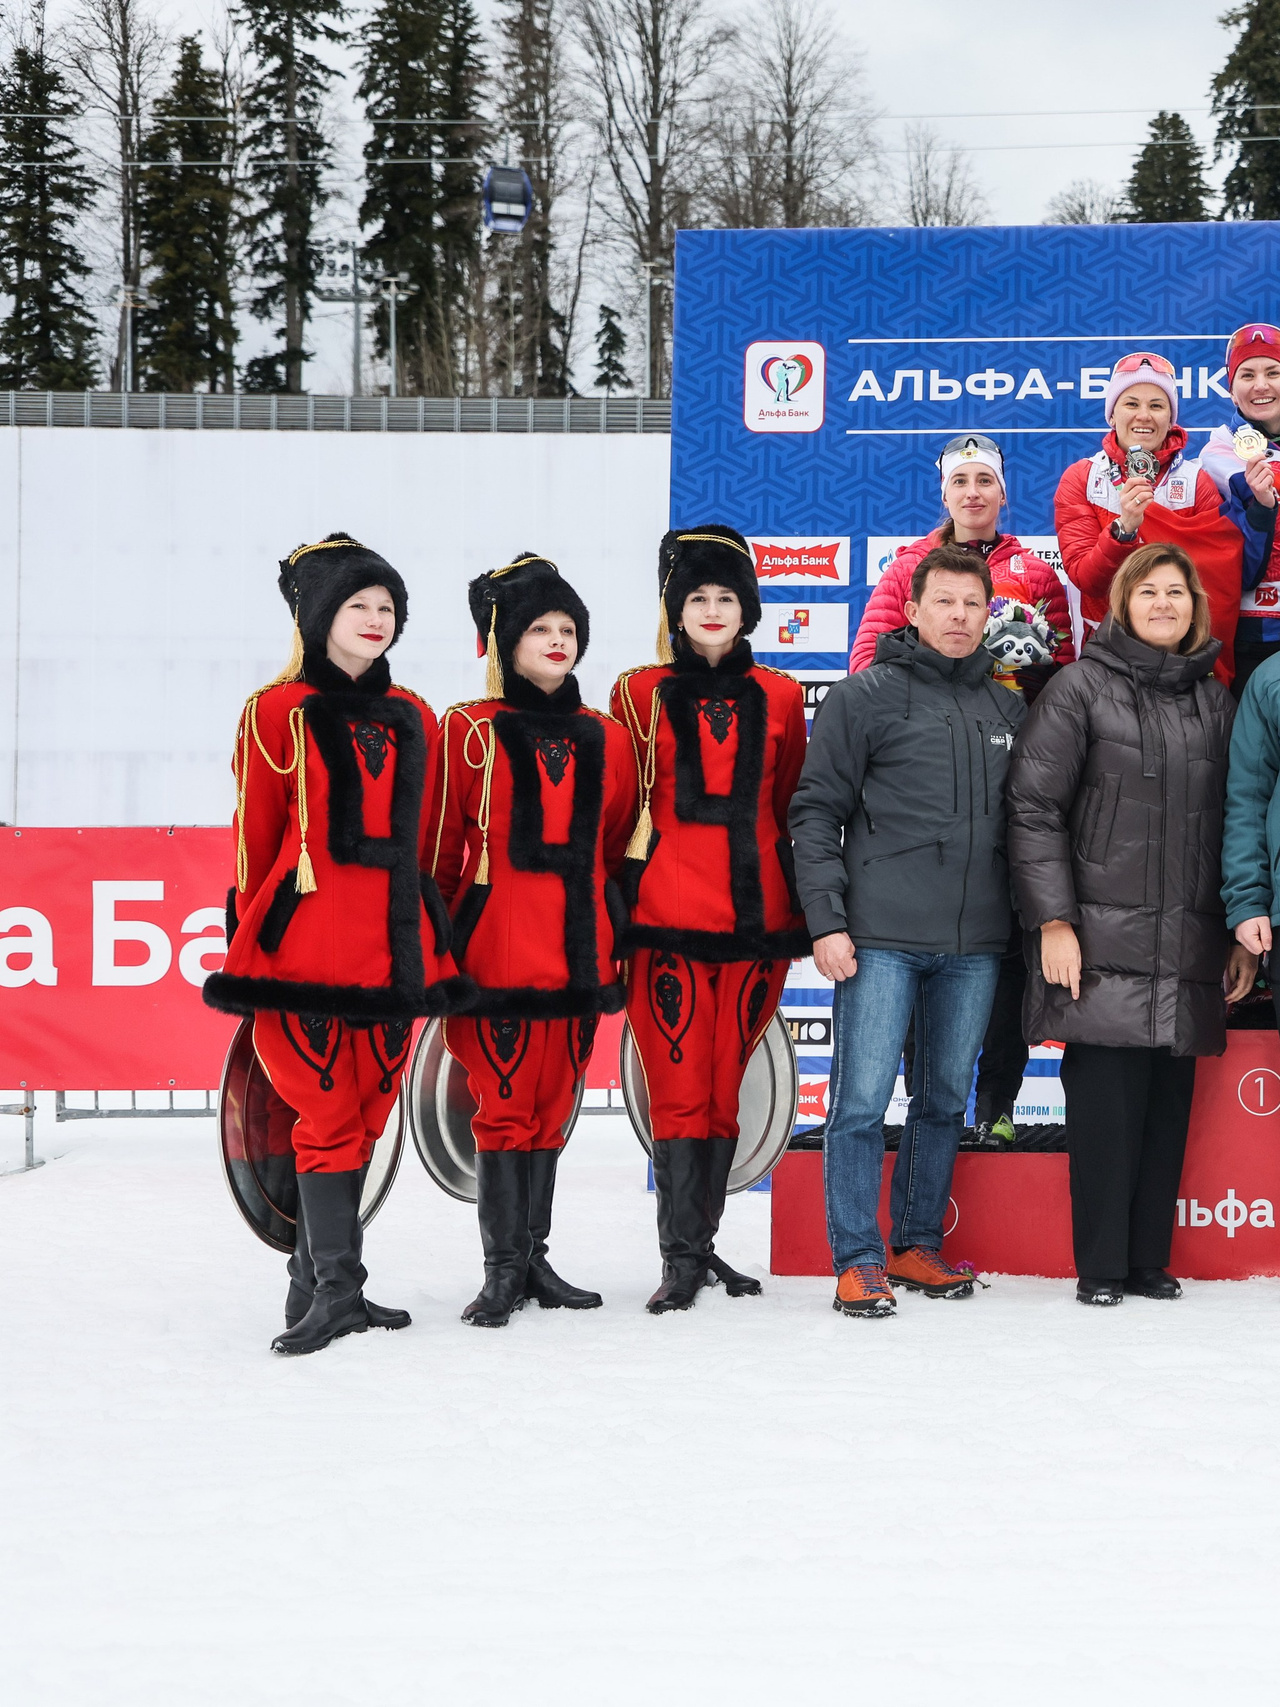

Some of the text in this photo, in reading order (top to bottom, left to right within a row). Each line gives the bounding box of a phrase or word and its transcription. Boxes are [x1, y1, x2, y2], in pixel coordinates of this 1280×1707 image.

[848, 366, 1231, 402] АЛЬФА-БНК
[758, 408, 809, 418] Альфа Банк
[762, 554, 829, 568] Альфа Банк
[1037, 551, 1060, 559] ТЕХ
[1254, 1077, 1264, 1107] 1
[798, 1095, 818, 1104] анк
[1014, 1105, 1050, 1116] АЗПРОМ
[1176, 1188, 1276, 1238] льфа
